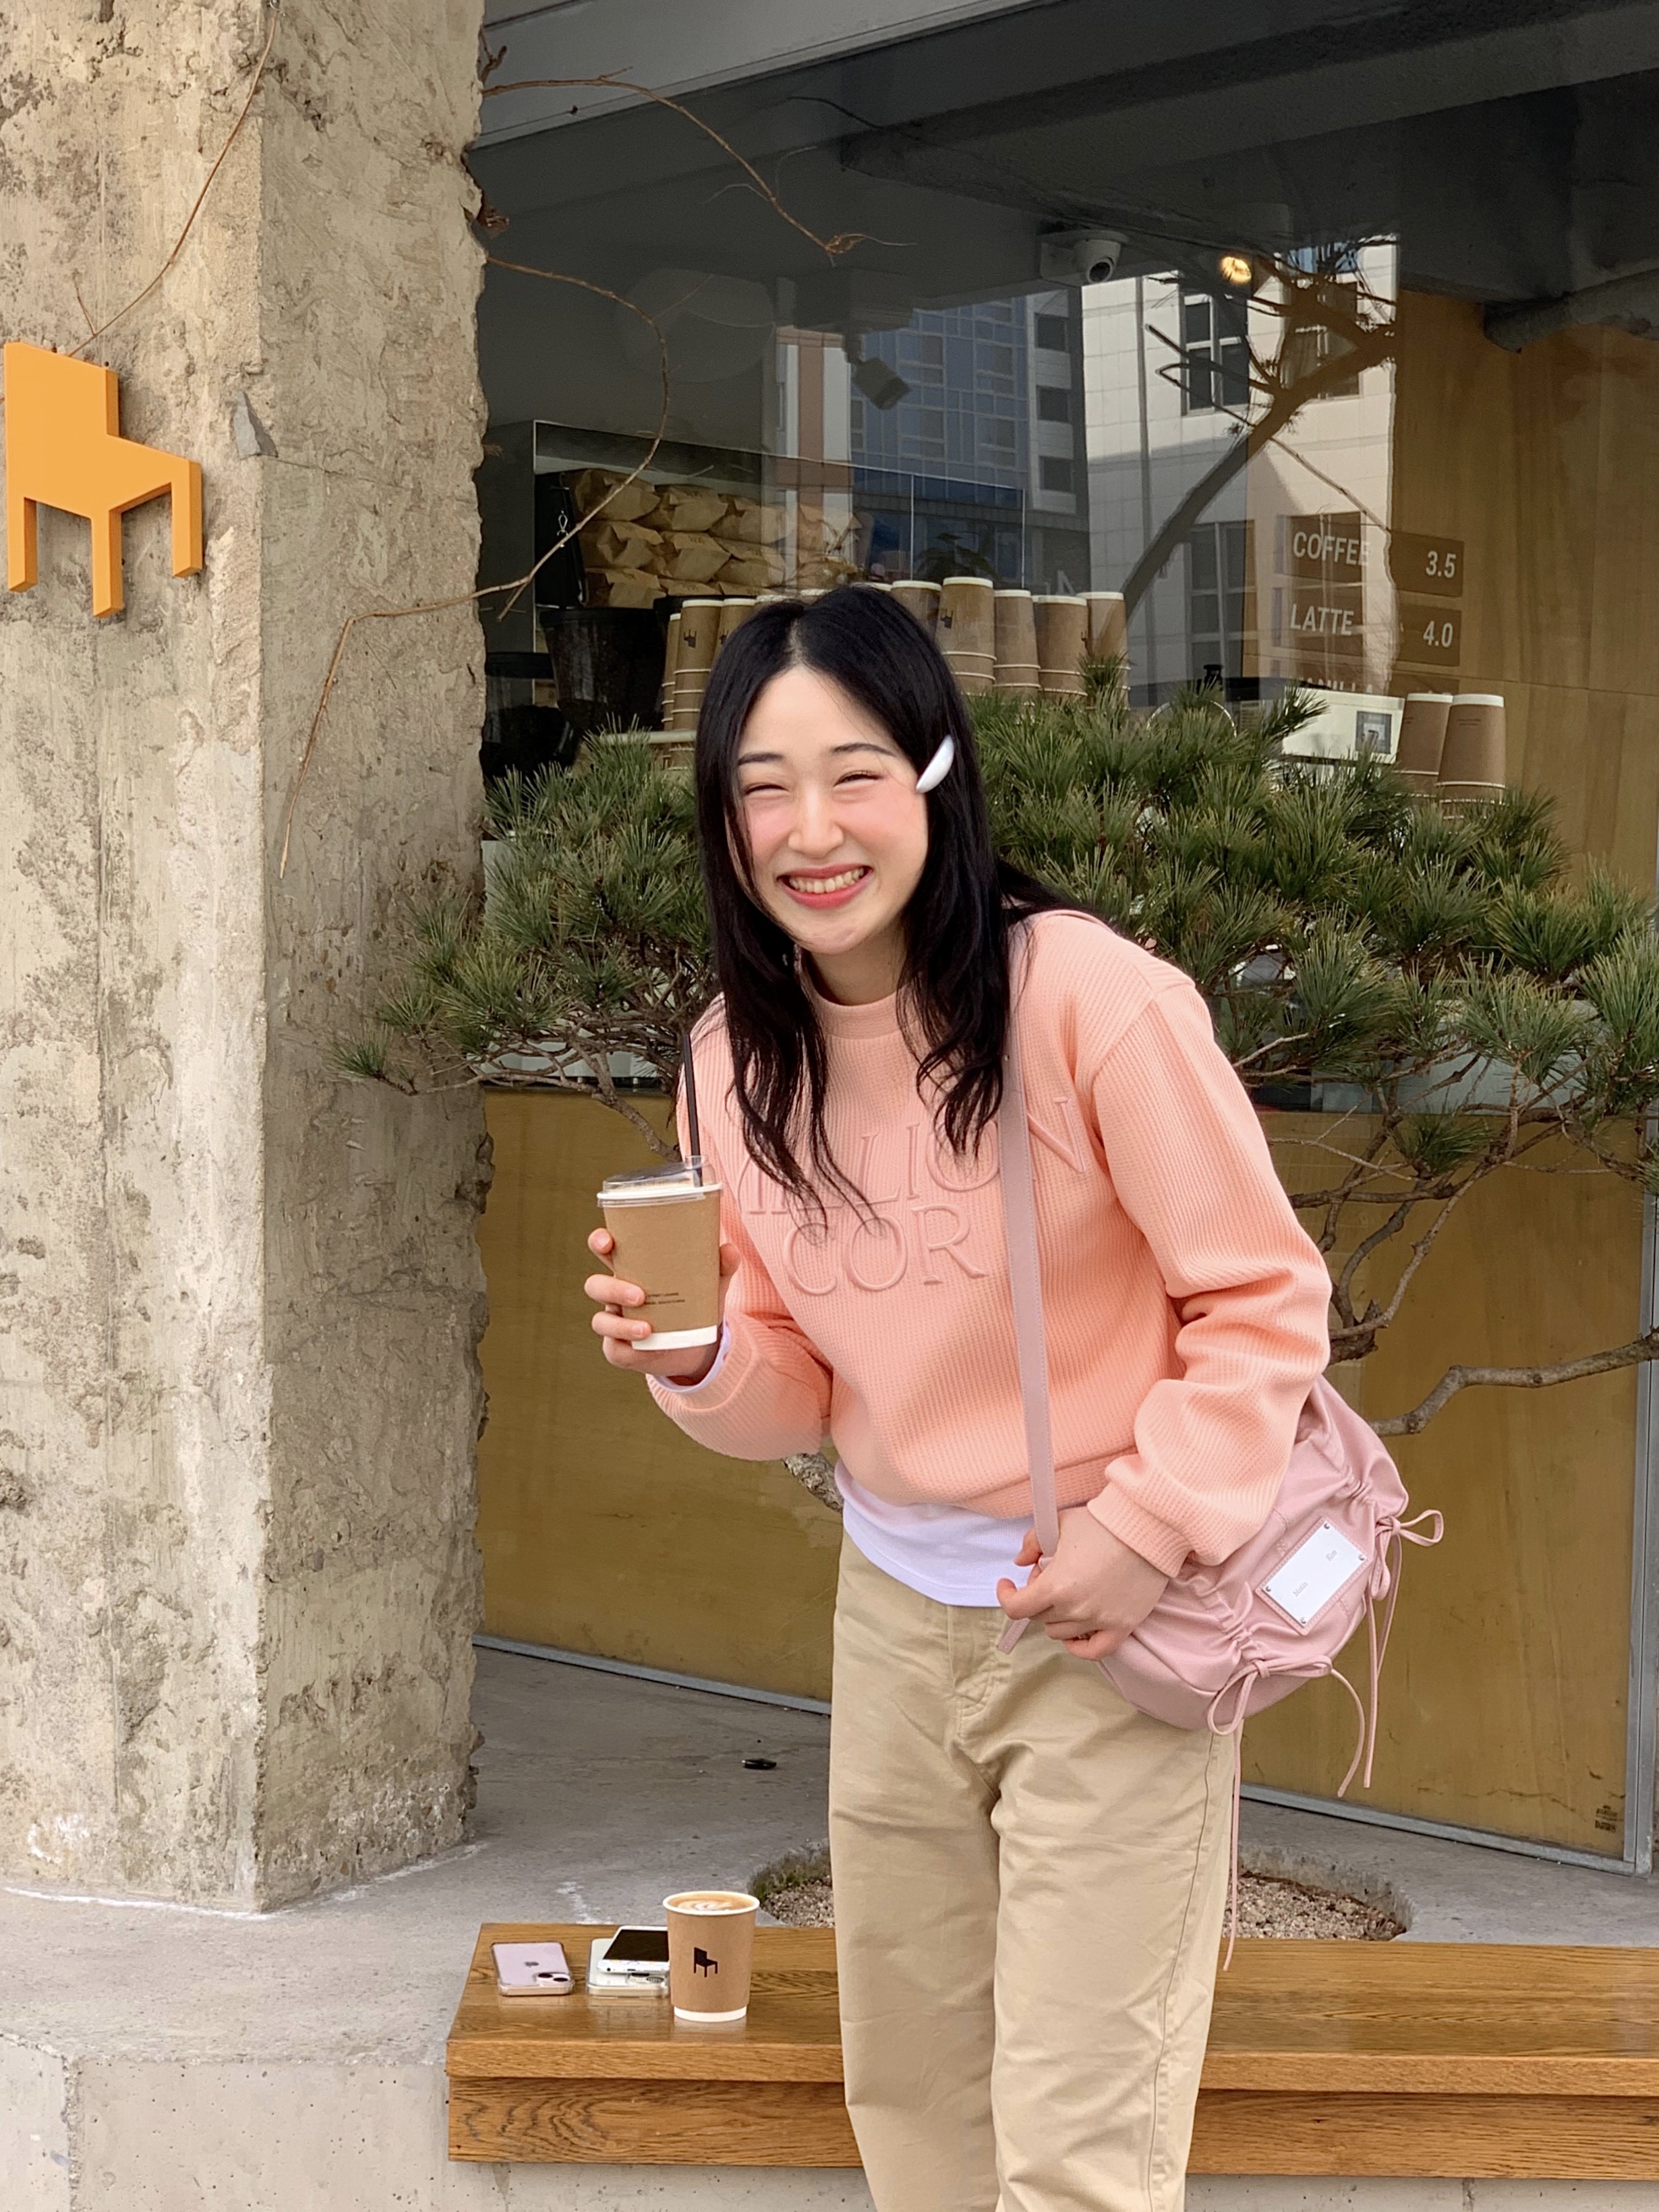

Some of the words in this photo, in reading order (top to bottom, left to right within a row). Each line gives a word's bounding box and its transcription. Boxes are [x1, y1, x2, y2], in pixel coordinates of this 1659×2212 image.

[1293, 531, 1371, 566] COFFEE
[1426, 550, 1457, 579] 3.5
[1289, 603, 1355, 636] LATTE
[1422, 620, 1453, 648] 4.0
[782, 1204, 989, 1296] COR
